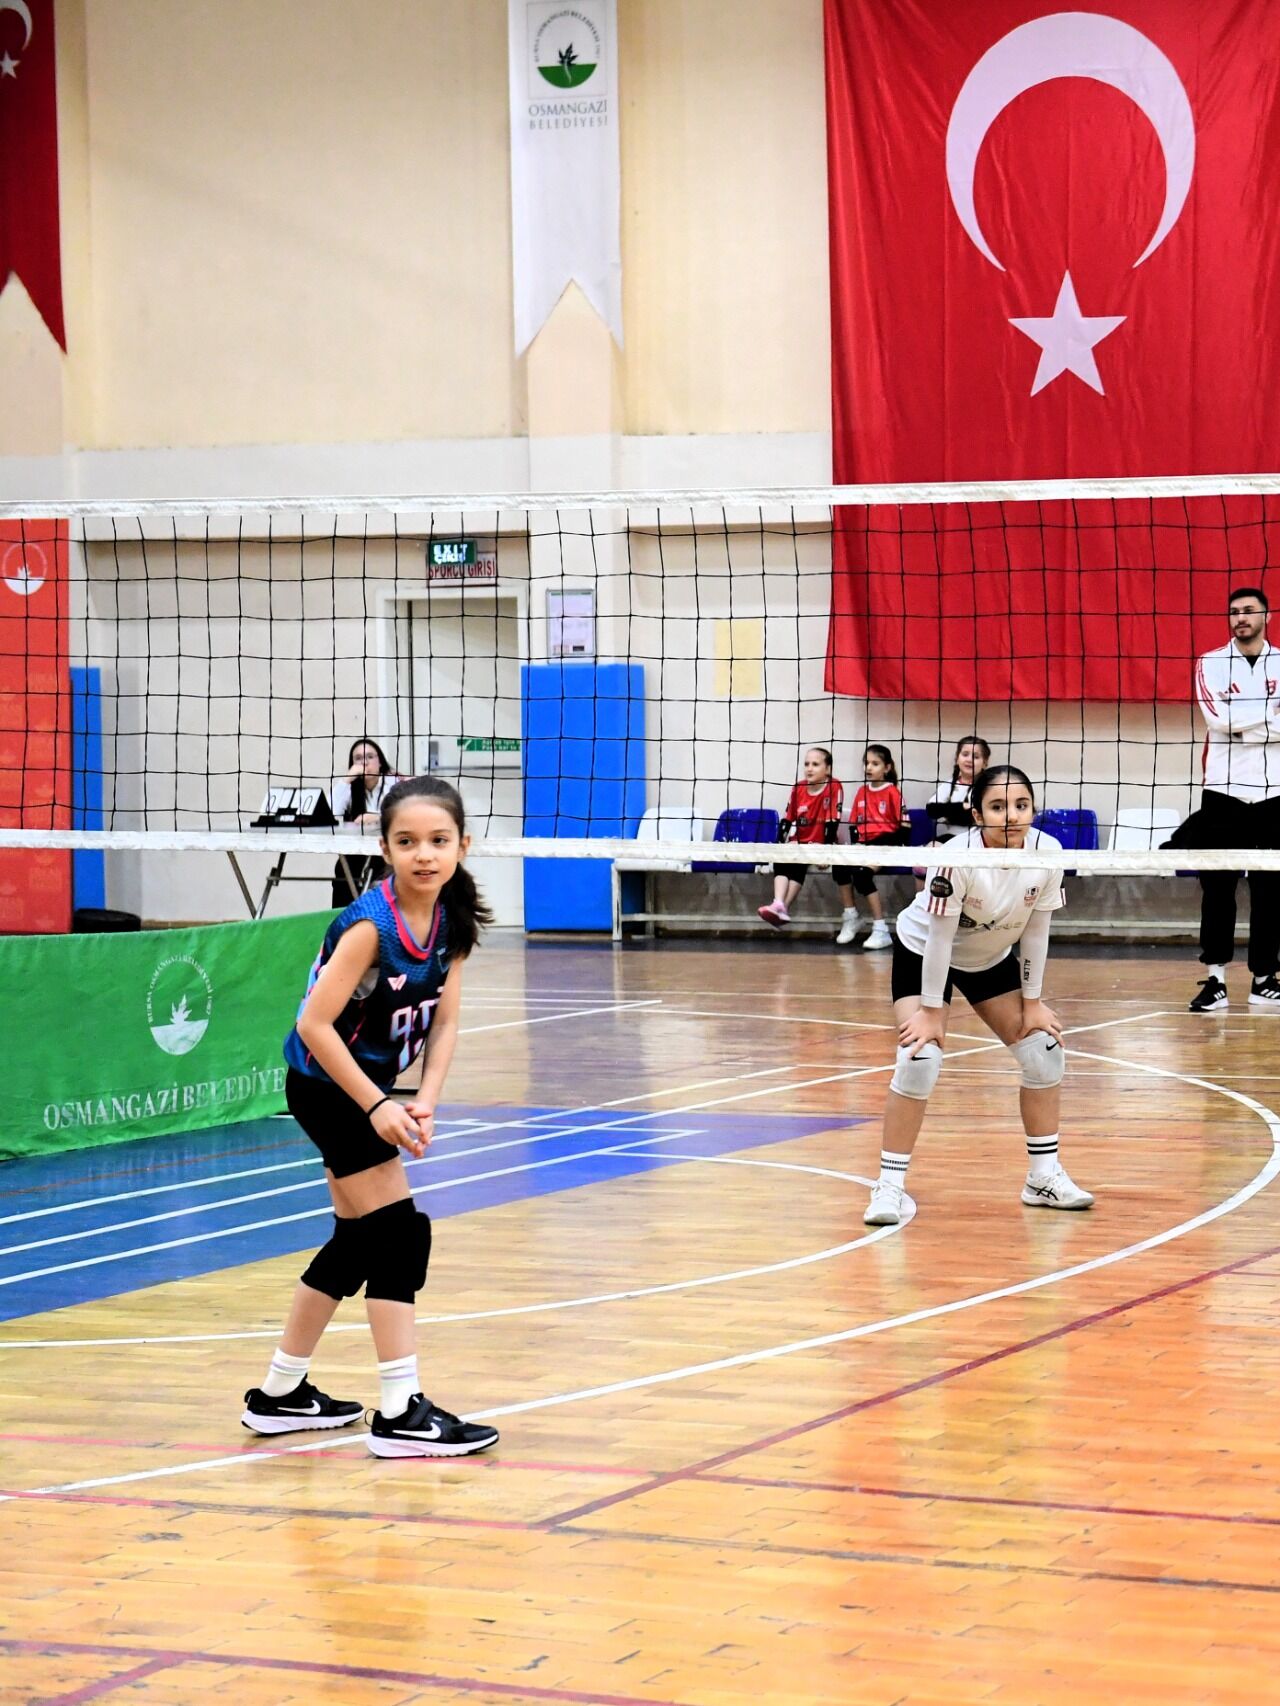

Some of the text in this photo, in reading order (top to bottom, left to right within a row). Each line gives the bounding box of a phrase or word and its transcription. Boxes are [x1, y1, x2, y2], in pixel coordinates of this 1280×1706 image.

[528, 99, 608, 117] OSMANGAZİ
[529, 115, 608, 130] BELEDİYESİ
[43, 1066, 286, 1131] OSMANGAZİ BELEDİYE
